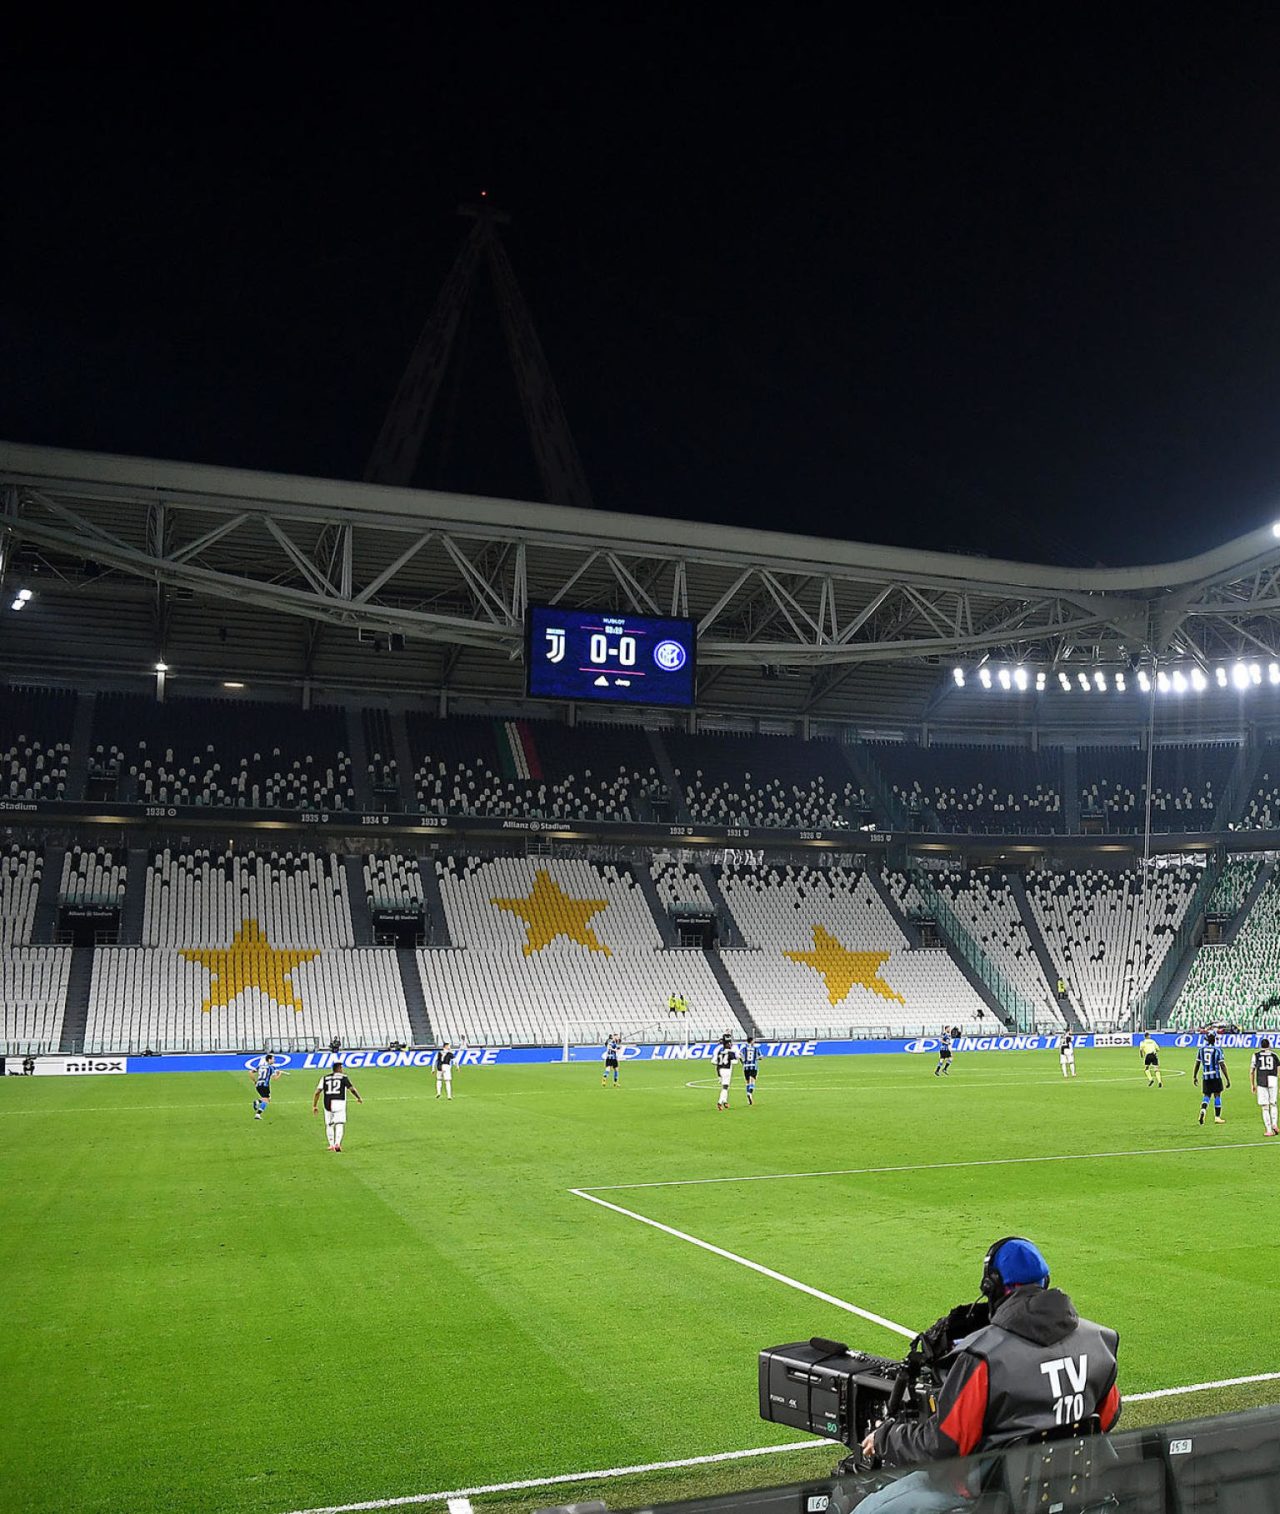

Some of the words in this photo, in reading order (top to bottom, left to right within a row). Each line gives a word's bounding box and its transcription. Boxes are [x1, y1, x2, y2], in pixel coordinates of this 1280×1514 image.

[590, 633, 636, 666] 0-0
[0, 803, 38, 812] Stadium
[301, 814, 319, 822] 1935
[362, 816, 379, 824] 1934
[421, 818, 438, 826] 1933
[503, 821, 529, 829] Allianz
[540, 822, 571, 830] Stadium
[950, 1037, 1040, 1051] LINGLONG
[1045, 1035, 1088, 1049] TIE
[1096, 1036, 1131, 1045] nilox
[766, 1043, 817, 1057] TIRE
[303, 1051, 433, 1069] LINGLONG
[719, 1054, 729, 1065] 14
[1204, 1053, 1211, 1065] 9
[1259, 1056, 1274, 1070] 19
[67, 1060, 123, 1072] nilox
[325, 1079, 341, 1095] 12
[1040, 1354, 1088, 1399] TV
[1053, 1393, 1084, 1425] 170
[1171, 1441, 1188, 1453] 159
[810, 1497, 828, 1509] 160
